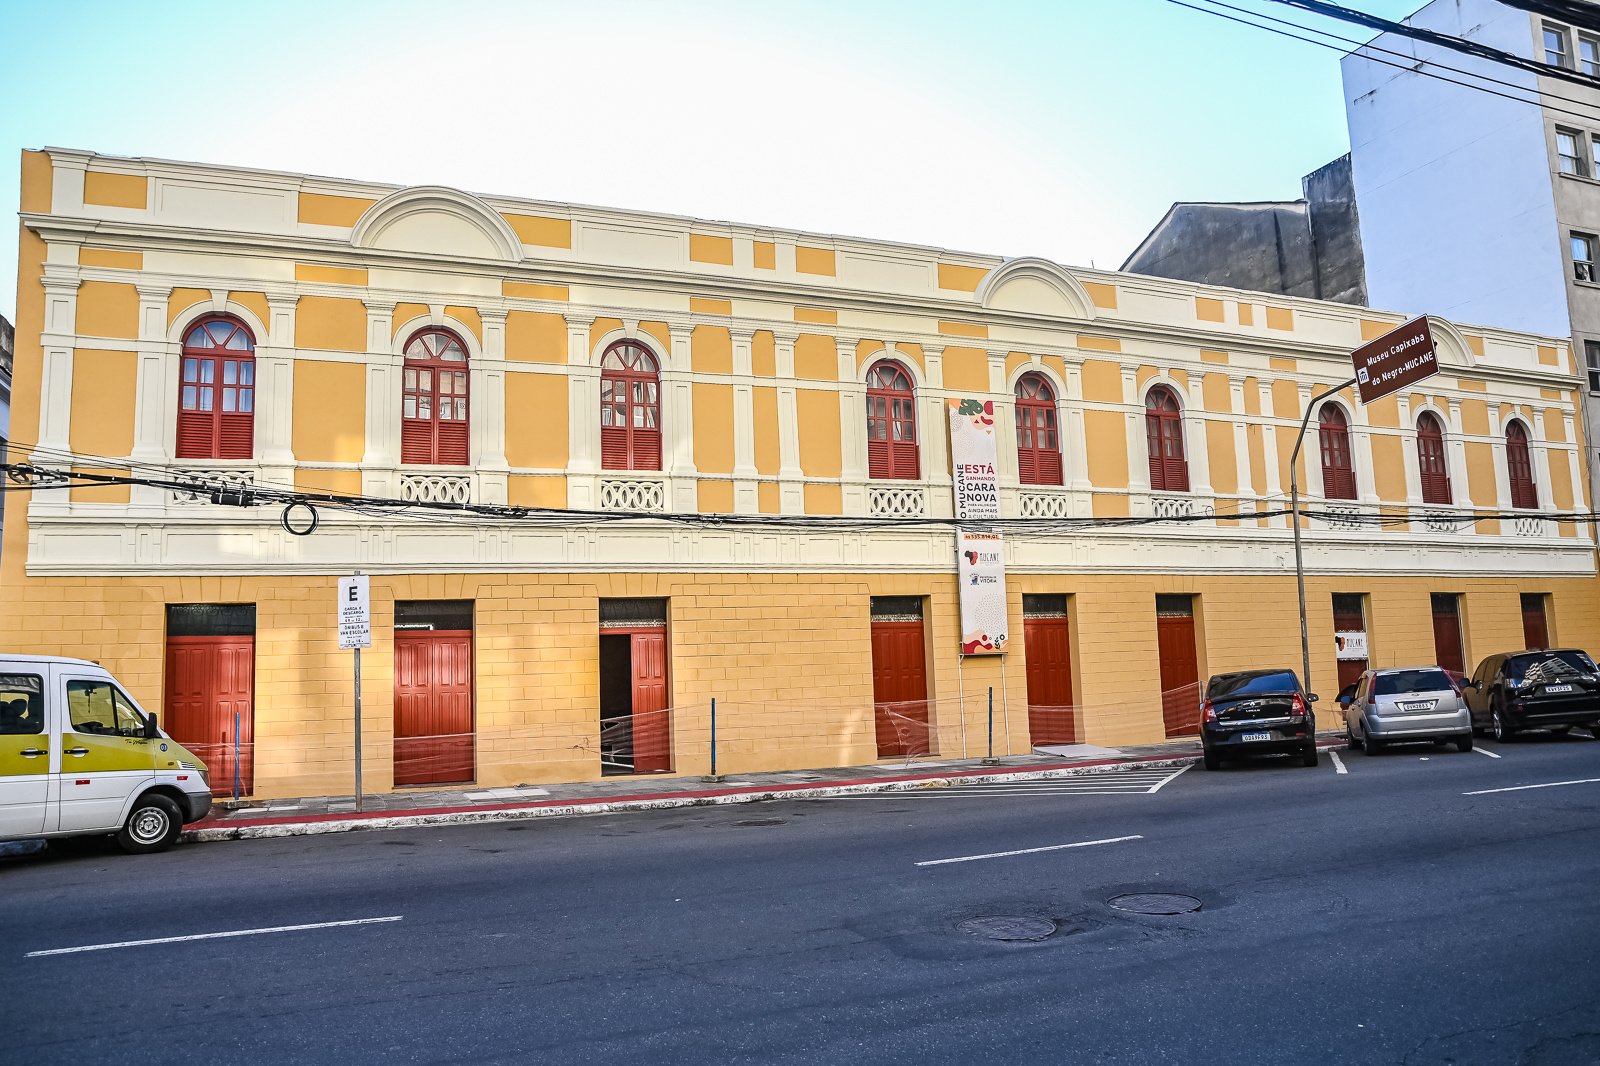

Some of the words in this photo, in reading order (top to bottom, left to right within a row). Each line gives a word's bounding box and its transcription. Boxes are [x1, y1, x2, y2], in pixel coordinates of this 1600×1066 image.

[1366, 350, 1389, 366] Museu
[1390, 333, 1425, 355] Capixaba
[1372, 377, 1381, 386] do
[1381, 351, 1434, 381] Negro-MUCANE
[965, 462, 994, 474] ESTÁ
[957, 464, 966, 508] MUCANE
[966, 483, 996, 491] CARA
[966, 494, 996, 502] NOVA
[960, 511, 967, 519] O
[349, 586, 358, 601] E
